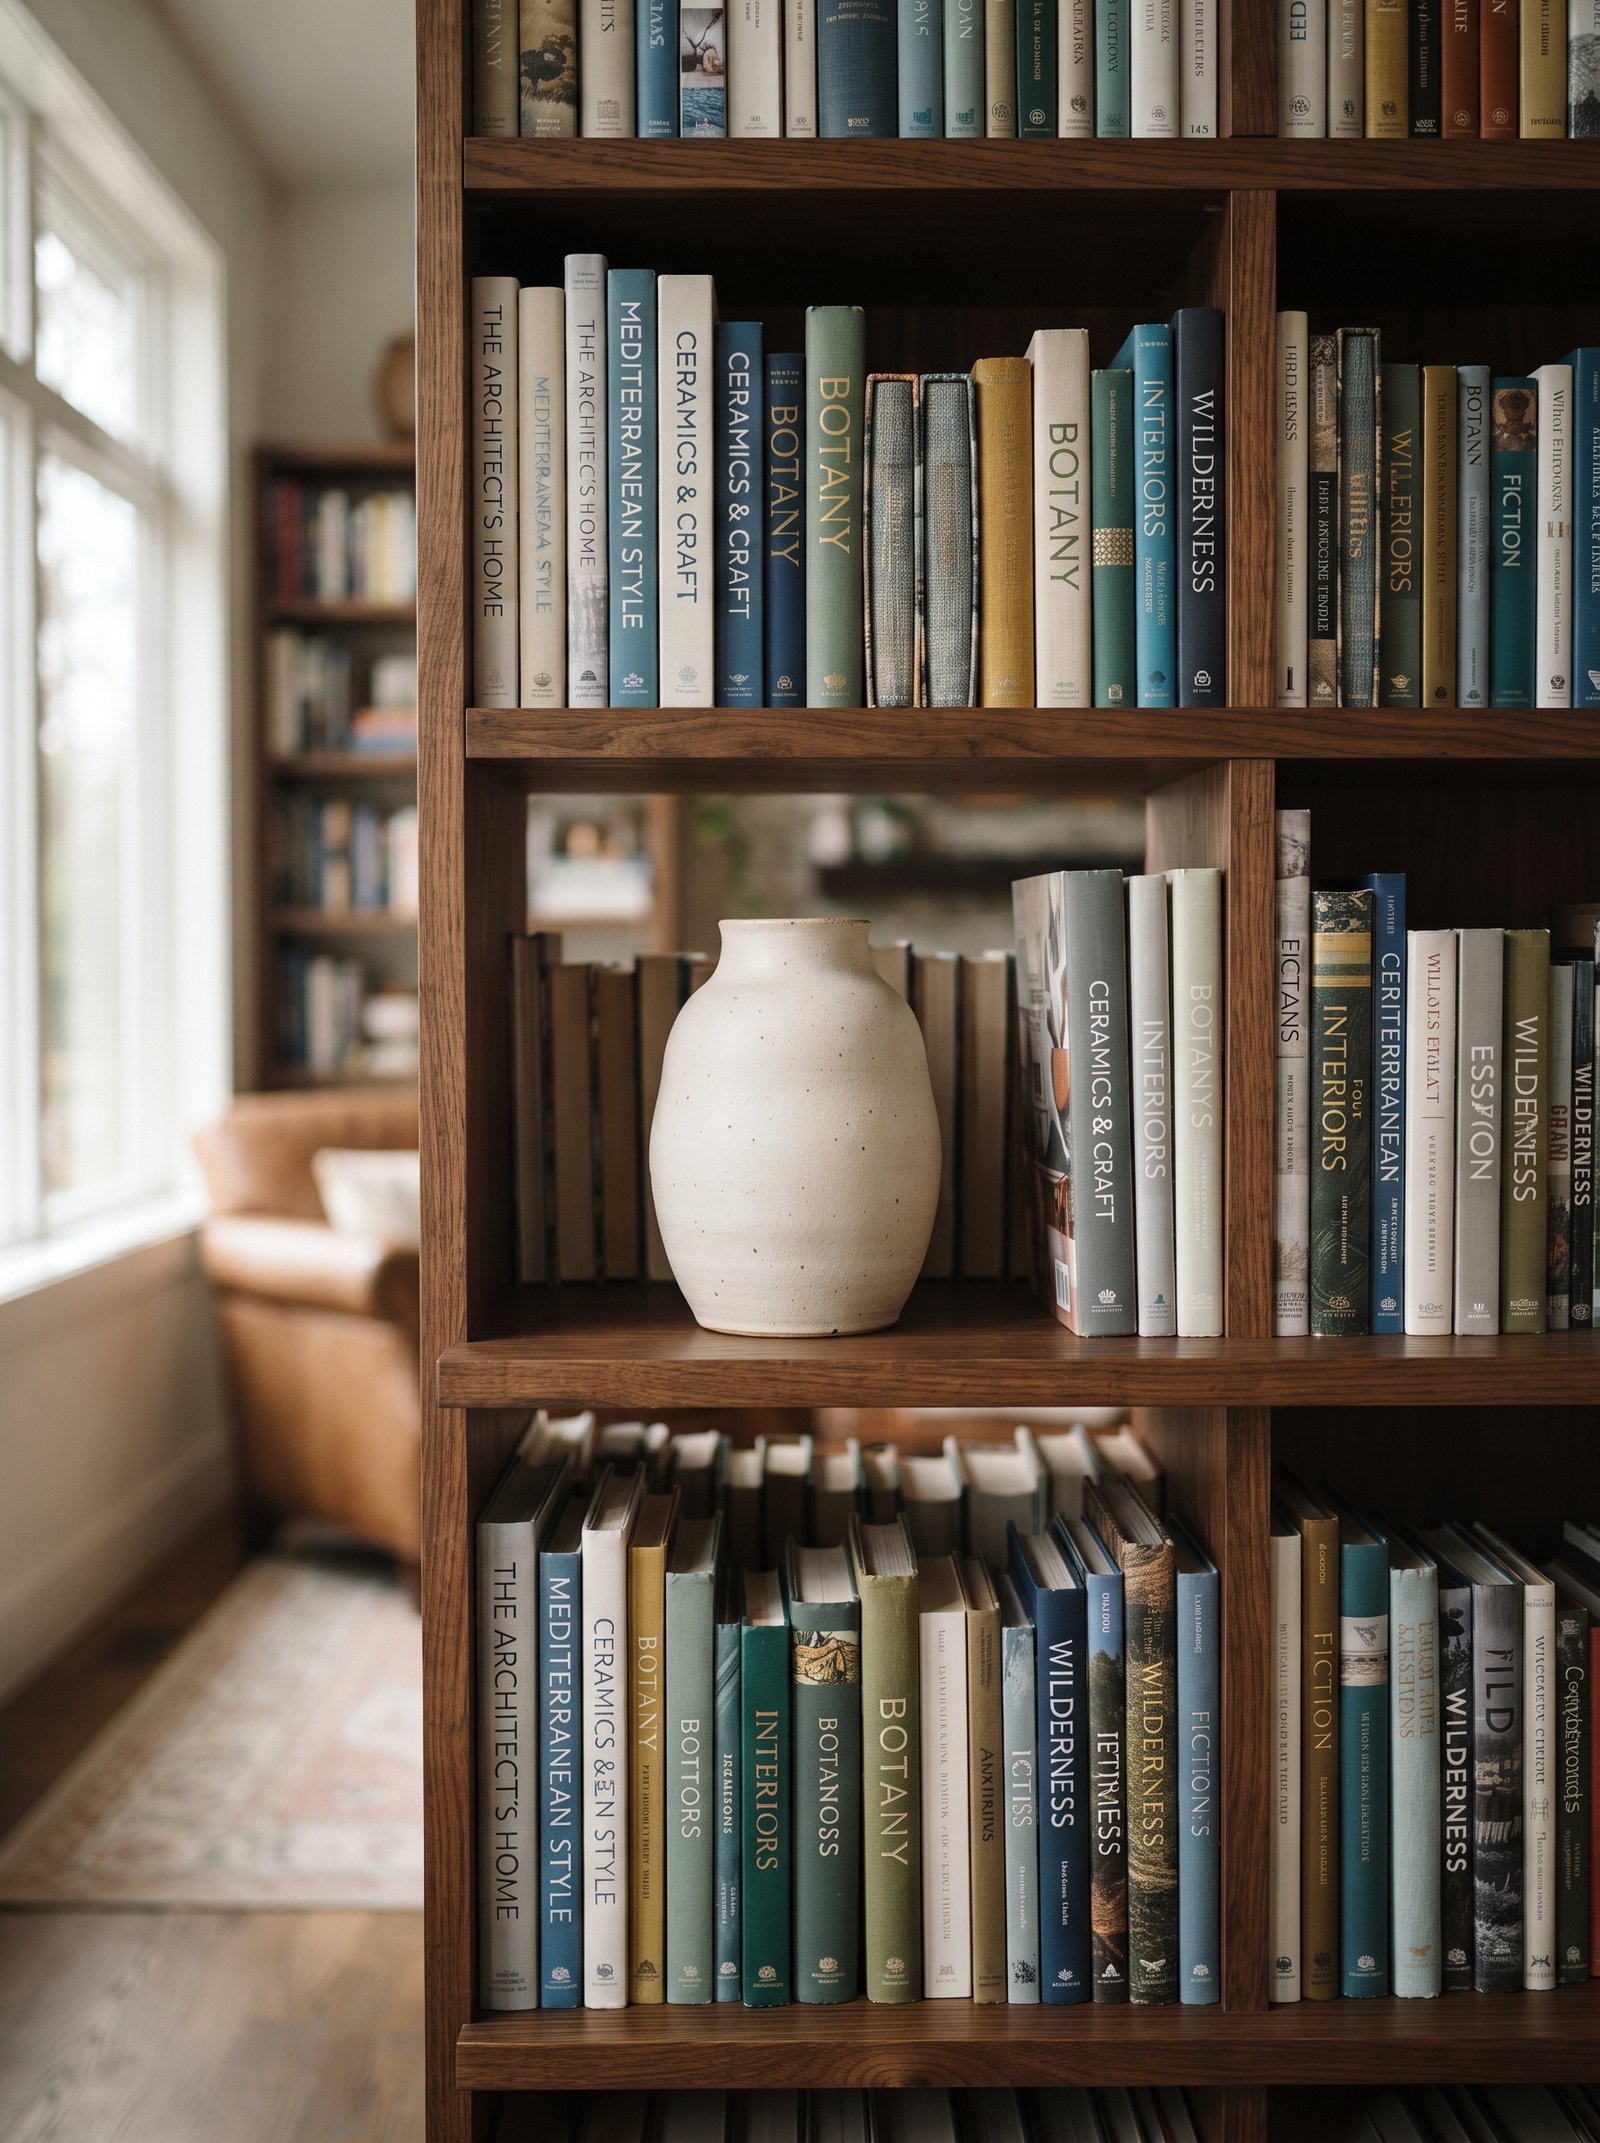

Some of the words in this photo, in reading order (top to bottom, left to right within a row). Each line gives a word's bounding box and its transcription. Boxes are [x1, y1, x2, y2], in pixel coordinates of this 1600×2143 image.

[1191, 125, 1208, 133] 145
[483, 306, 502, 355] THE
[578, 320, 595, 361] THE
[483, 364, 503, 529] ARCHITECT'S
[621, 303, 642, 537] MEDITERRANEAN
[676, 331, 697, 475] CERAMICS
[729, 352, 750, 493] CERAMICS
[819, 376, 850, 554] BOTANY
[1143, 380, 1165, 536] INTERIORS
[579, 504, 595, 566] HOME
[677, 486, 697, 504] &
[728, 503, 749, 521] &
[771, 406, 799, 566] BOTANY
[1049, 423, 1079, 590] BOTANY
[1192, 390, 1214, 592] WILDERNESS
[1502, 475, 1521, 566] FICTION
[483, 540, 503, 617] HOME
[622, 548, 643, 628] STYLE
[677, 513, 697, 603] CRAFT
[729, 530, 750, 619] CRAFT
[1089, 981, 1111, 1108] CERAMICS
[1142, 1021, 1166, 1179] INTERIORS
[1189, 985, 1213, 1127] BOTANYS
[1322, 1006, 1347, 1170] INTERIORS
[1093, 1115, 1112, 1135] &
[1094, 1142, 1114, 1222] CRAFT
[1574, 1063, 1592, 1205] WILDERNESS
[494, 1562, 516, 1619] THE
[494, 1629, 518, 1821] ARCHITECT'S
[549, 1578, 571, 1825] MEDITERRANEAN
[594, 1619, 615, 1749] CERAMICS
[637, 1636, 657, 1751] BOTANY
[1049, 1640, 1074, 1827] WILDERNESS
[1313, 1633, 1334, 1749] FICTION
[681, 1720, 701, 1838] BOTTORS
[756, 1711, 778, 1869] INTERIORS
[819, 1718, 839, 1856] BOTANOSS
[879, 1698, 908, 1867] BOTANY
[1142, 1662, 1164, 1847] WILDERNESS
[1446, 1688, 1467, 1872] WILDERNESS
[496, 1832, 519, 1920] HOME
[550, 1840, 571, 1923] STYLE
[595, 1830, 615, 1905] STYLE
